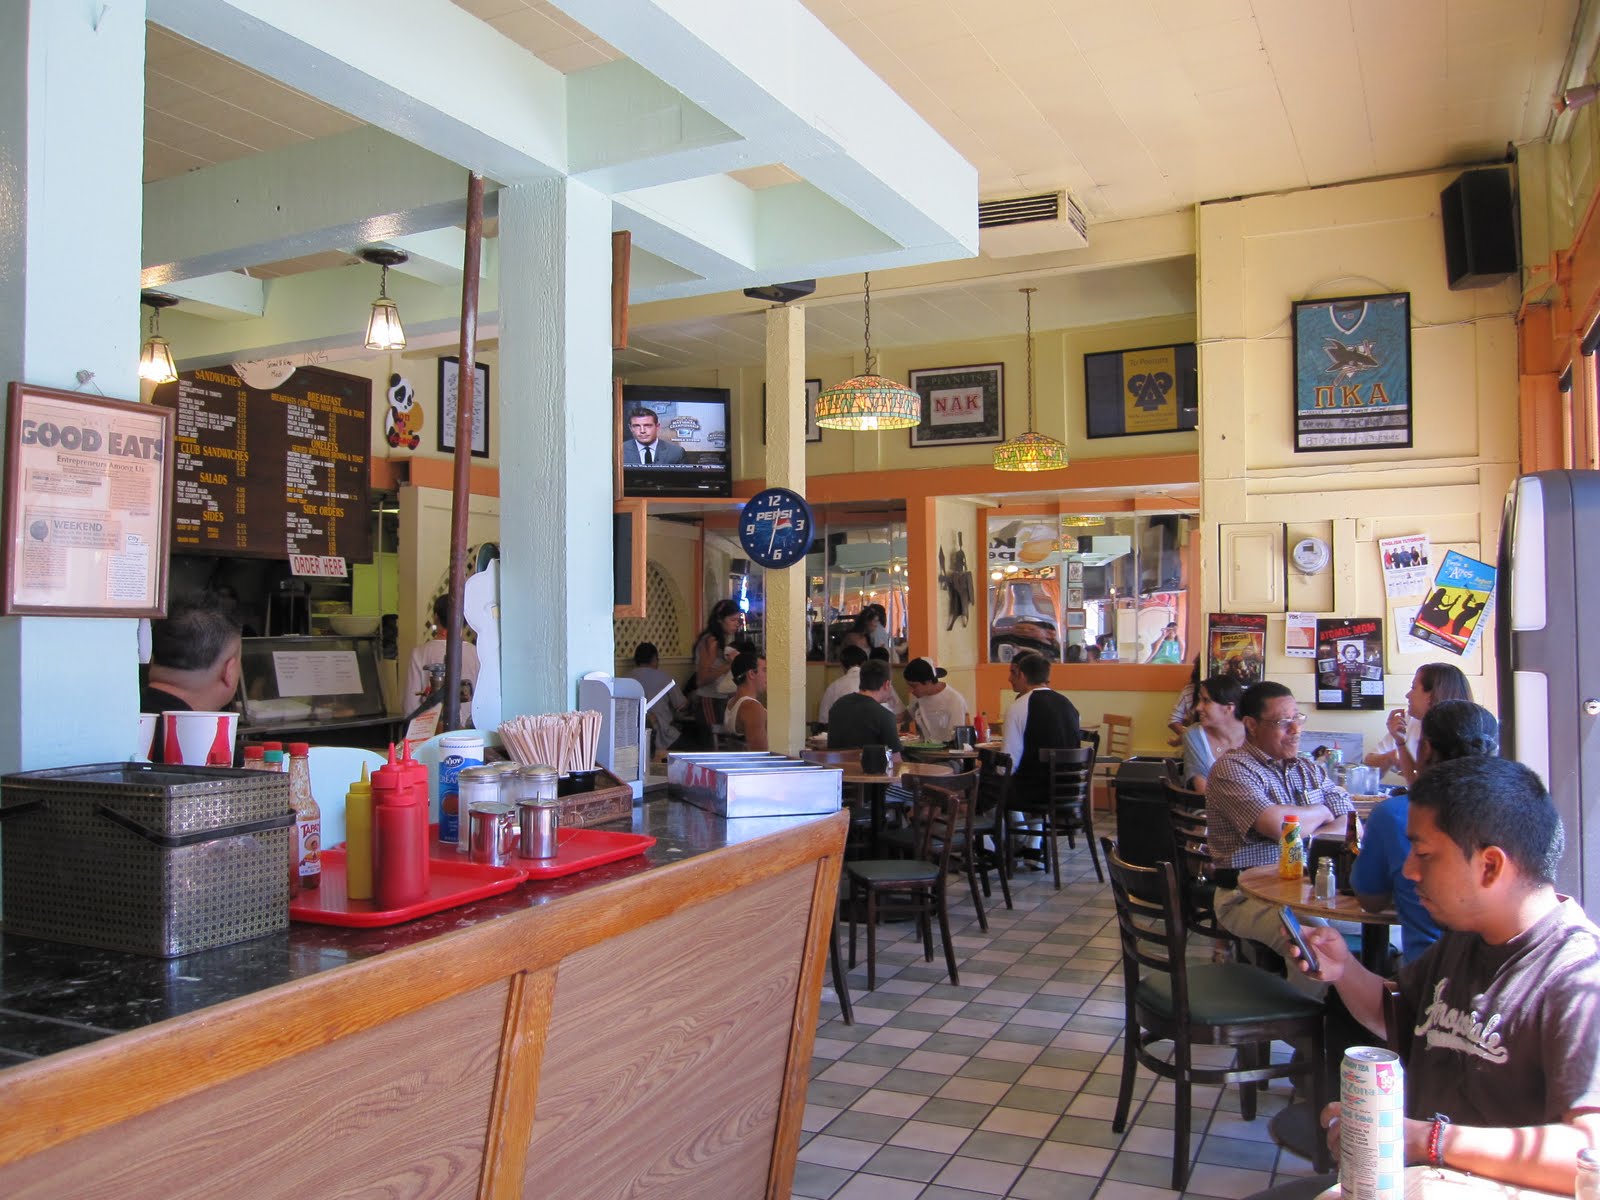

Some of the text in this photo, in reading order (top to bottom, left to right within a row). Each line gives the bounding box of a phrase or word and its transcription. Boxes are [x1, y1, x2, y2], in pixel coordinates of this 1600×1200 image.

[196, 370, 241, 387] SANDWICHES
[307, 391, 342, 407] BREAKFAST
[21, 419, 102, 453] GOOD
[182, 443, 248, 461] CLUB SANDWICHES
[311, 440, 338, 453] OMELETS
[57, 454, 145, 473] Entrepreneurs Among Us
[200, 472, 227, 485] SALADS
[768, 495, 782, 507] 12
[203, 511, 224, 522] SIDES
[303, 504, 345, 518] SIDE ORDERS
[756, 509, 793, 522] PEPSI
[53, 519, 103, 532] WEEKEND
[746, 524, 756, 536] 9
[795, 519, 805, 531] 3
[773, 549, 782, 560] 6
[294, 556, 344, 576] ORDER HERE
[1319, 627, 1352, 641] ATOMIC
[1353, 622, 1377, 635] MOM
